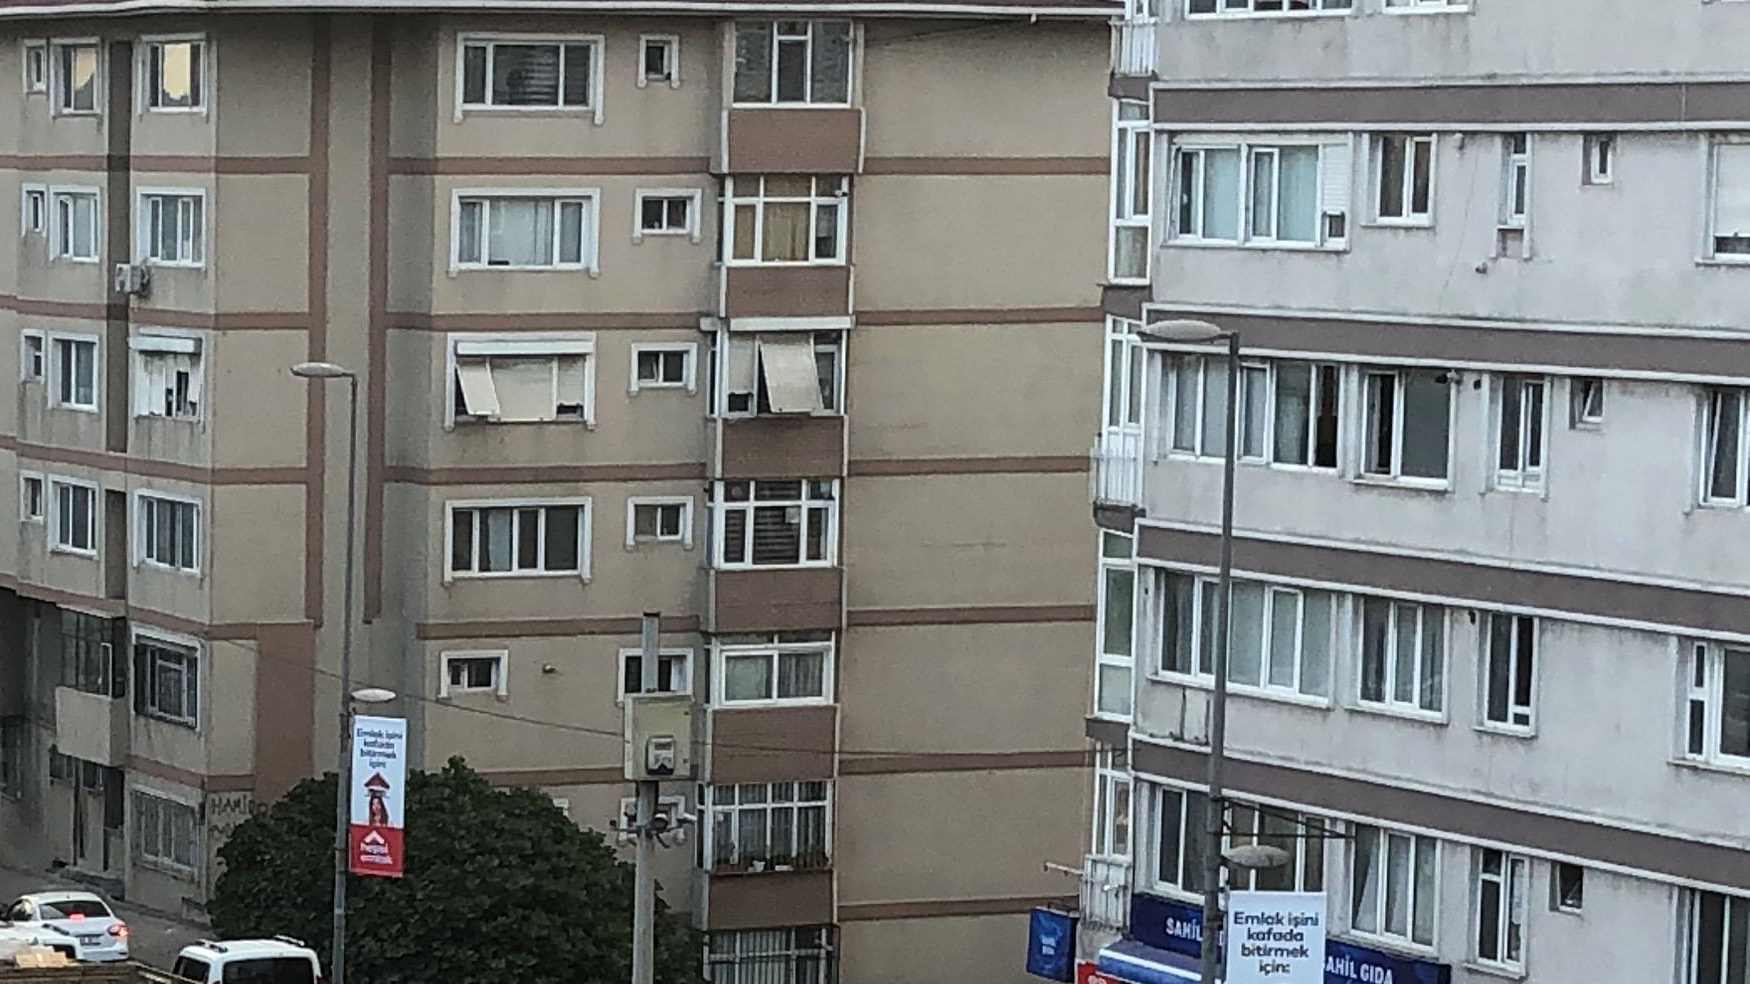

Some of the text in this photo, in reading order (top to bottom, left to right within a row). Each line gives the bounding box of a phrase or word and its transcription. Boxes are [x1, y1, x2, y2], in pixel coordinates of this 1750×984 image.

[1233, 911, 1319, 928] Emlak işini
[1166, 917, 1203, 941] SAHİL
[1246, 927, 1304, 942] kafada
[1240, 944, 1310, 959] bitirmek
[1324, 953, 1357, 979] AHİL
